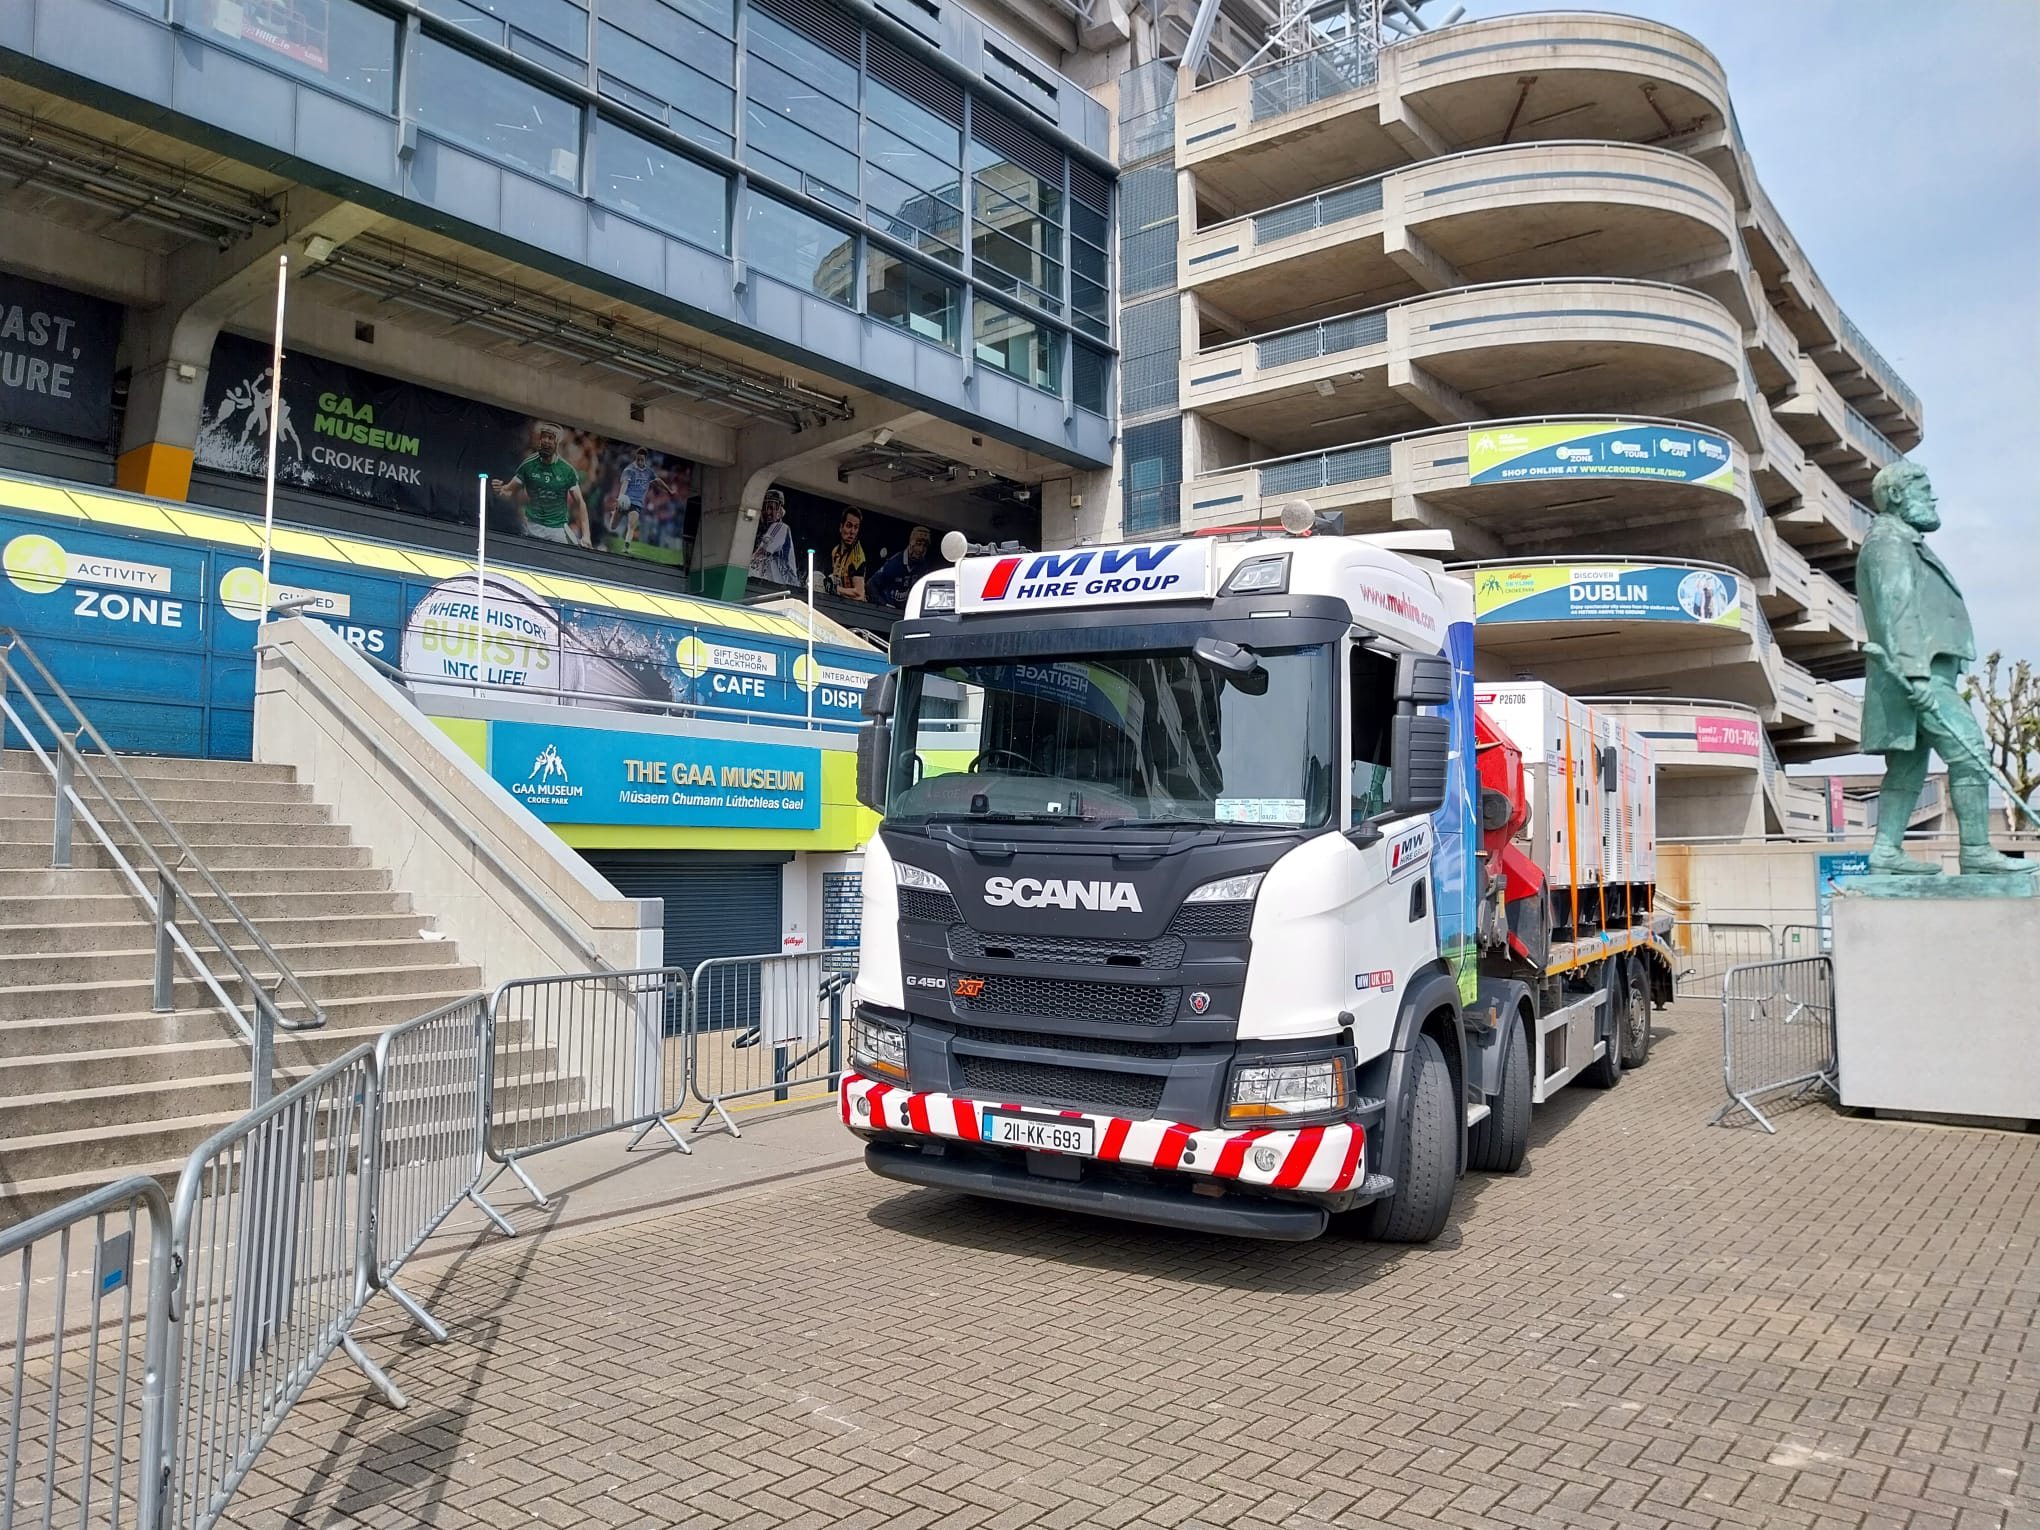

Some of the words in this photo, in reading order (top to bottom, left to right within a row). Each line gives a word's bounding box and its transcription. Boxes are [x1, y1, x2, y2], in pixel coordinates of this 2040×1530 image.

[0, 351, 74, 399] URE
[318, 392, 374, 424] GAA
[314, 416, 420, 456] MUSEUM
[1570, 455, 1593, 463] ZONE
[1624, 451, 1648, 459] TOURS
[311, 446, 375, 475] CROKE
[378, 461, 422, 486] PARK
[1502, 468, 1528, 477] SHOP
[1529, 466, 1564, 475] ONLINE
[1024, 543, 1182, 579] MW
[77, 563, 158, 583] ACTIVITY
[1574, 572, 1614, 580] DISCOVER
[1017, 582, 1079, 599] HIRE
[1085, 574, 1180, 594] GROUP
[1569, 584, 1648, 602] DUBLIN
[74, 589, 183, 628] ZONE
[1360, 583, 1436, 632] www.mwhire.com
[428, 602, 478, 621] WHERE
[487, 608, 548, 640] HISTORY
[421, 619, 551, 671] BURSTS
[713, 648, 733, 660] GIFT
[734, 651, 756, 663] SHOP
[757, 655, 763, 663] &
[713, 657, 768, 672] BLACKTHORN
[487, 668, 527, 686] LIFE!
[712, 673, 765, 698] CAFE
[822, 671, 870, 685] INTERACTIV
[1499, 694, 1526, 705] P26706
[623, 759, 667, 784] THE
[671, 762, 716, 787] GAA
[721, 767, 804, 792] MUSEUM
[512, 783, 537, 795] GAA
[538, 784, 583, 797] MUSEUM
[619, 790, 670, 805] Músaem
[672, 792, 723, 808] Chumann
[726, 795, 780, 810] Lúthchleas
[782, 798, 804, 811] Gael
[527, 797, 550, 805] CROKE
[551, 797, 569, 805] PARK
[1401, 831, 1424, 855] MW
[983, 876, 1143, 913] SCANIA
[953, 979, 985, 997] XT
[1357, 975, 1369, 988] MW
[1371, 973, 1380, 986] UK
[1382, 971, 1391, 984] LTD
[1004, 1122, 1081, 1150] 211-KK-693
